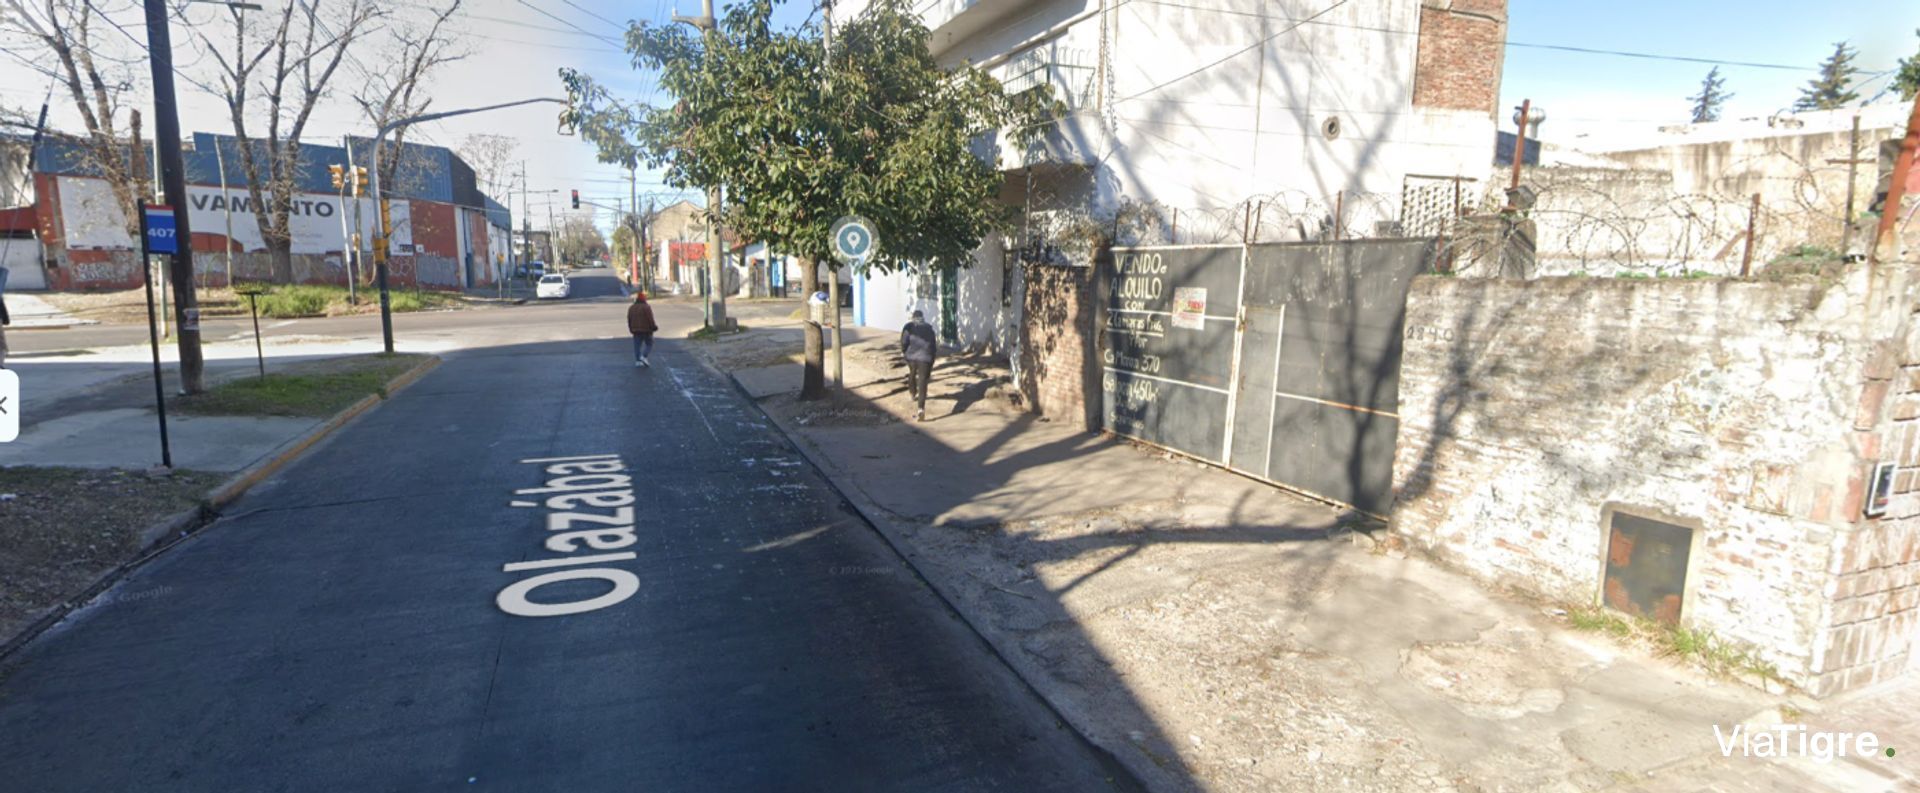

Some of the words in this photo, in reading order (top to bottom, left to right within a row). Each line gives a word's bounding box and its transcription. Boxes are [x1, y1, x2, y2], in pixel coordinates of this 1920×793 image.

[191, 194, 334, 217] VAMNTO
[147, 228, 176, 238] 407
[1114, 253, 1162, 275] VENDO
[1109, 276, 1162, 300] ALQUILO
